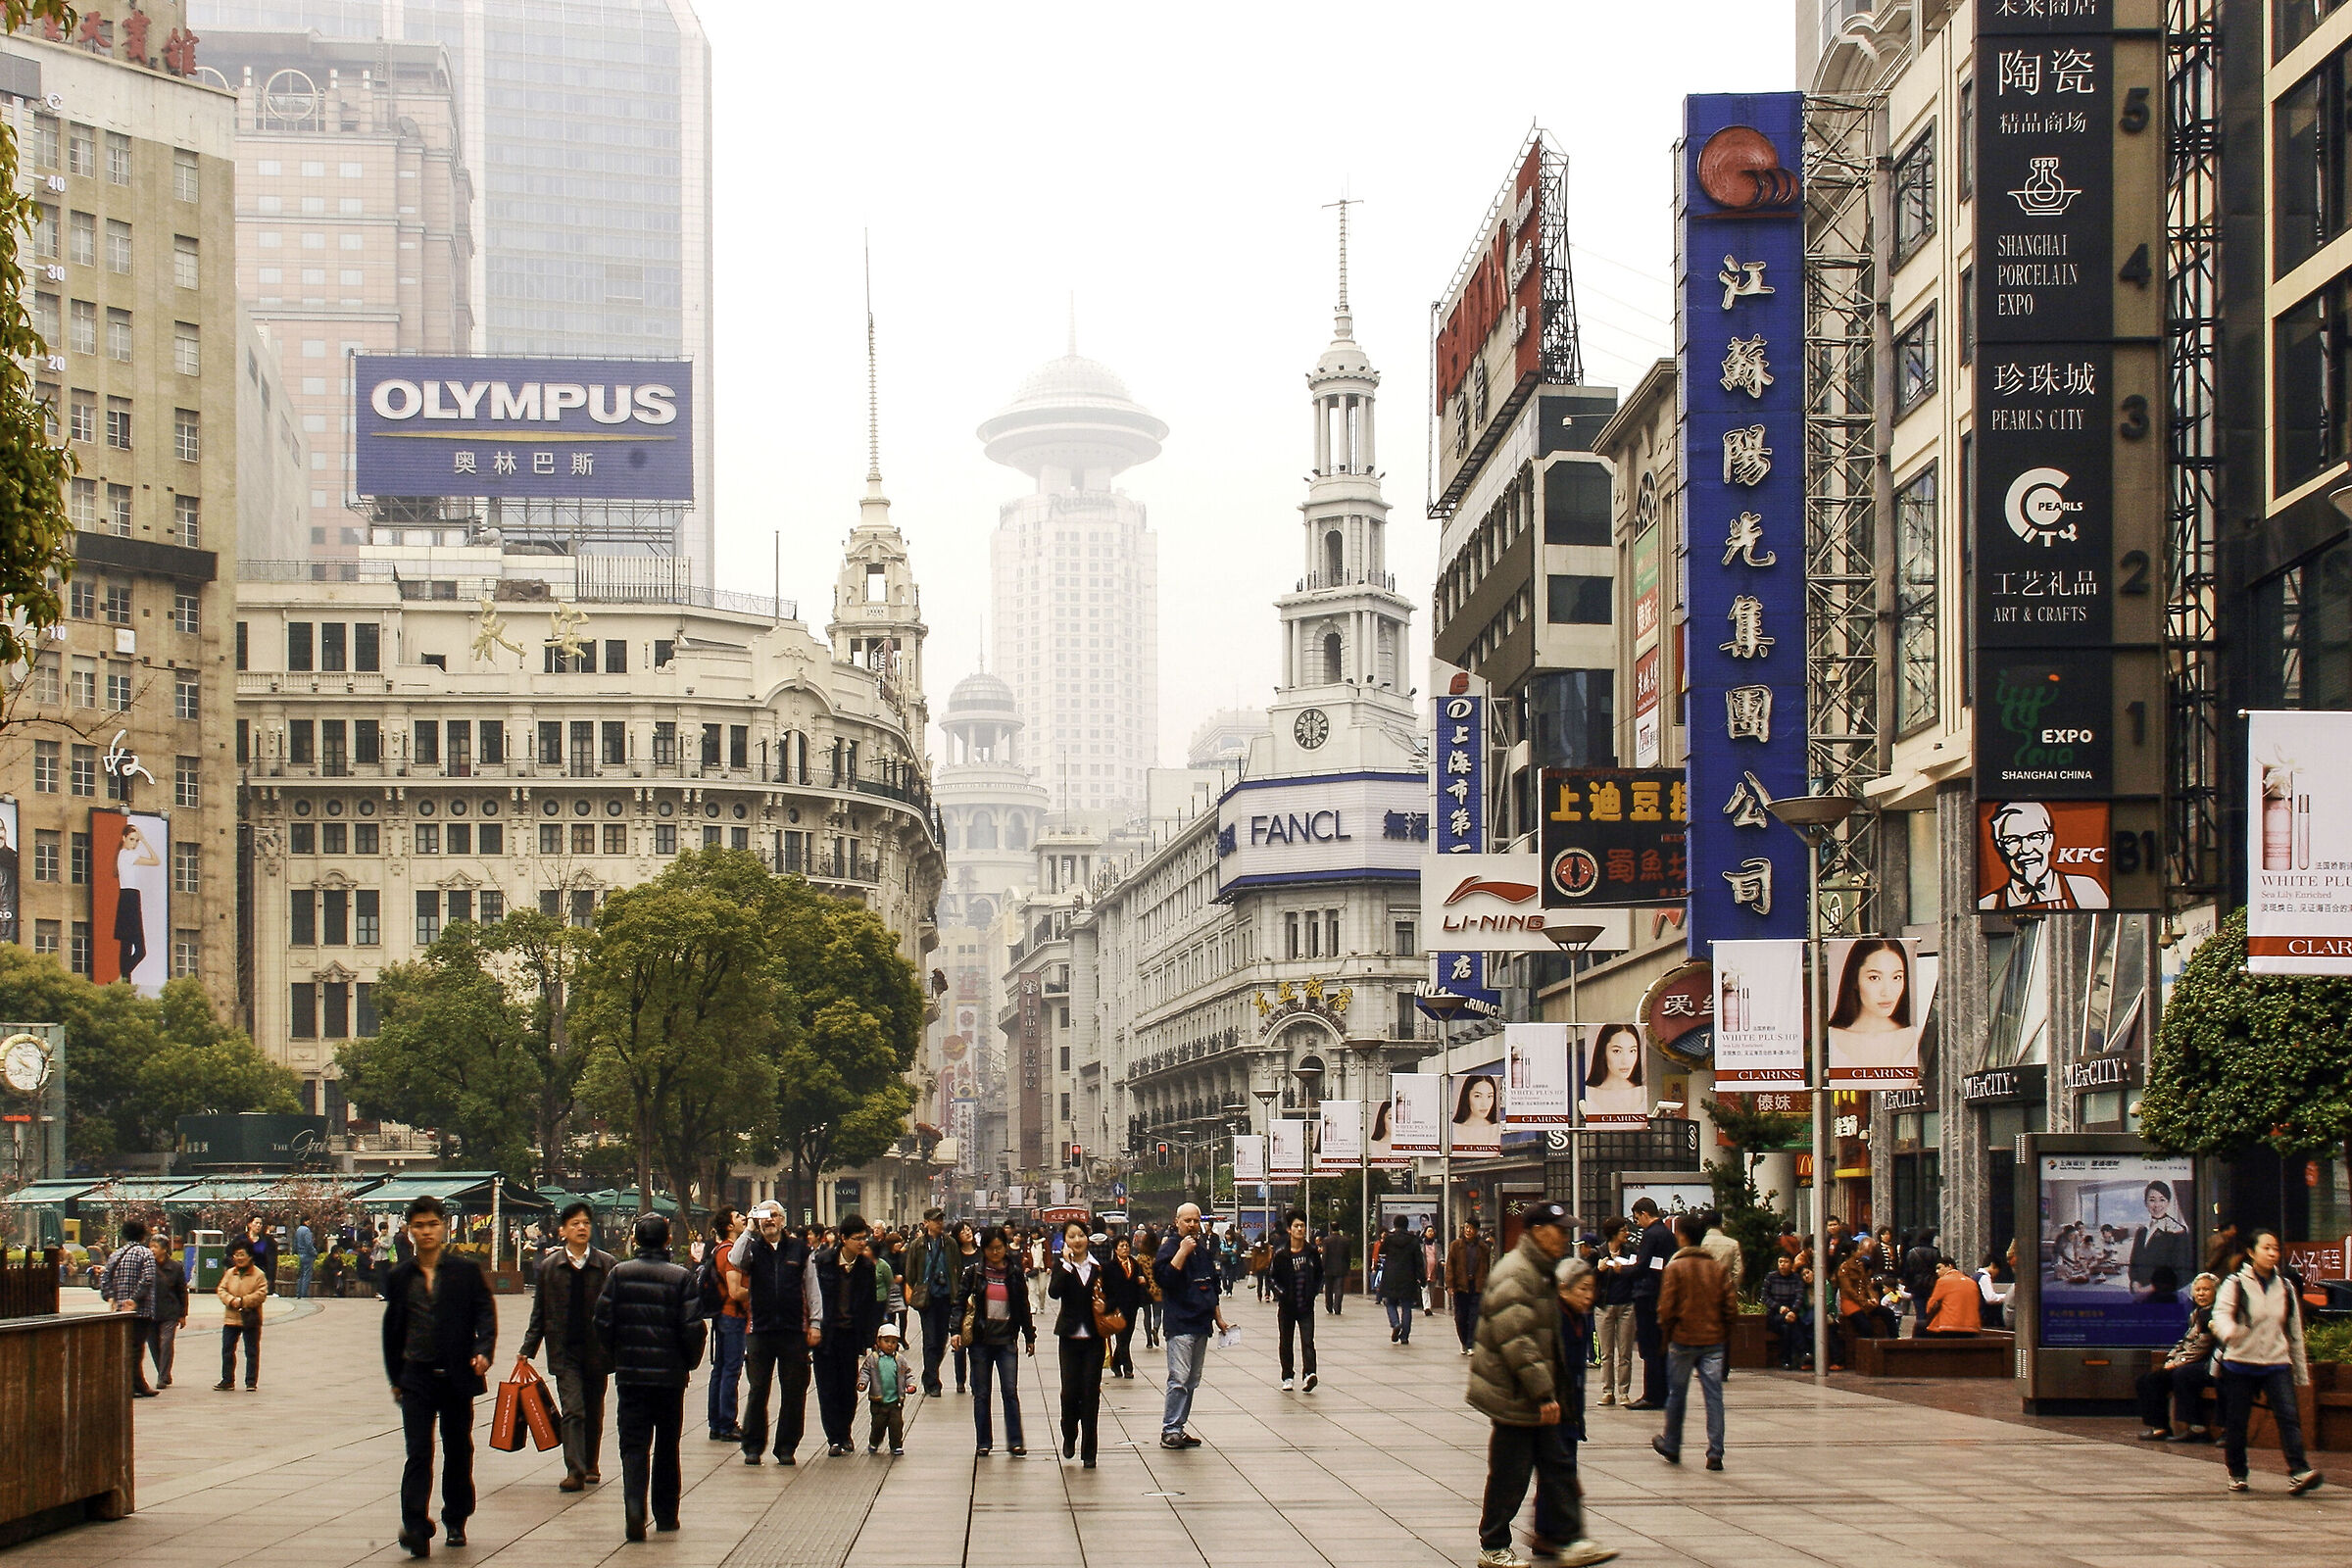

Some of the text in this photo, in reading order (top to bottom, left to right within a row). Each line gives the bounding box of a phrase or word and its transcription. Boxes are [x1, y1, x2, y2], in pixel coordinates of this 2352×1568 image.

[1998, 49, 2095, 96] 陶瓷
[2119, 87, 2150, 134] 5
[1999, 111, 2086, 134] 精品商场
[48, 174, 66, 192] 40
[1997, 234, 2069, 258] SHANGHAI
[48, 265, 66, 281] 30
[1997, 263, 2079, 287] PORCELAIN
[2118, 243, 2152, 290] 4
[1997, 294, 2034, 316] EXPO
[48, 355, 66, 371] 20
[1993, 362, 2095, 397] 珍珠城
[370, 378, 677, 425] OLYMPUS
[1991, 409, 2084, 431] PEARLS CITY
[2119, 396, 2150, 441] 3
[454, 451, 594, 475] 奥林巴斯
[2037, 501, 2083, 512] PEARLS
[1991, 569, 2098, 597] 工艺礼品
[2119, 549, 2150, 596] 2
[1717, 254, 1777, 916] 江蘇陽光集團公司
[1993, 605, 2087, 623] ART & CRAFTS
[2126, 701, 2145, 747] 1
[2041, 729, 2093, 744] EXPO
[2001, 770, 2093, 781] SHANGHAI CHINA
[1251, 810, 1351, 845] FANCL
[2057, 847, 2106, 863] KFC
[2114, 830, 2155, 876] B1
[2261, 875, 2319, 887] WHITE
[2278, 891, 2292, 901] Lily
[1443, 911, 1545, 932] LI-NING
[2288, 939, 2352, 955] CLAR
[1738, 1070, 1801, 1080] CLARINS
[1851, 1068, 1914, 1079] CLARINS
